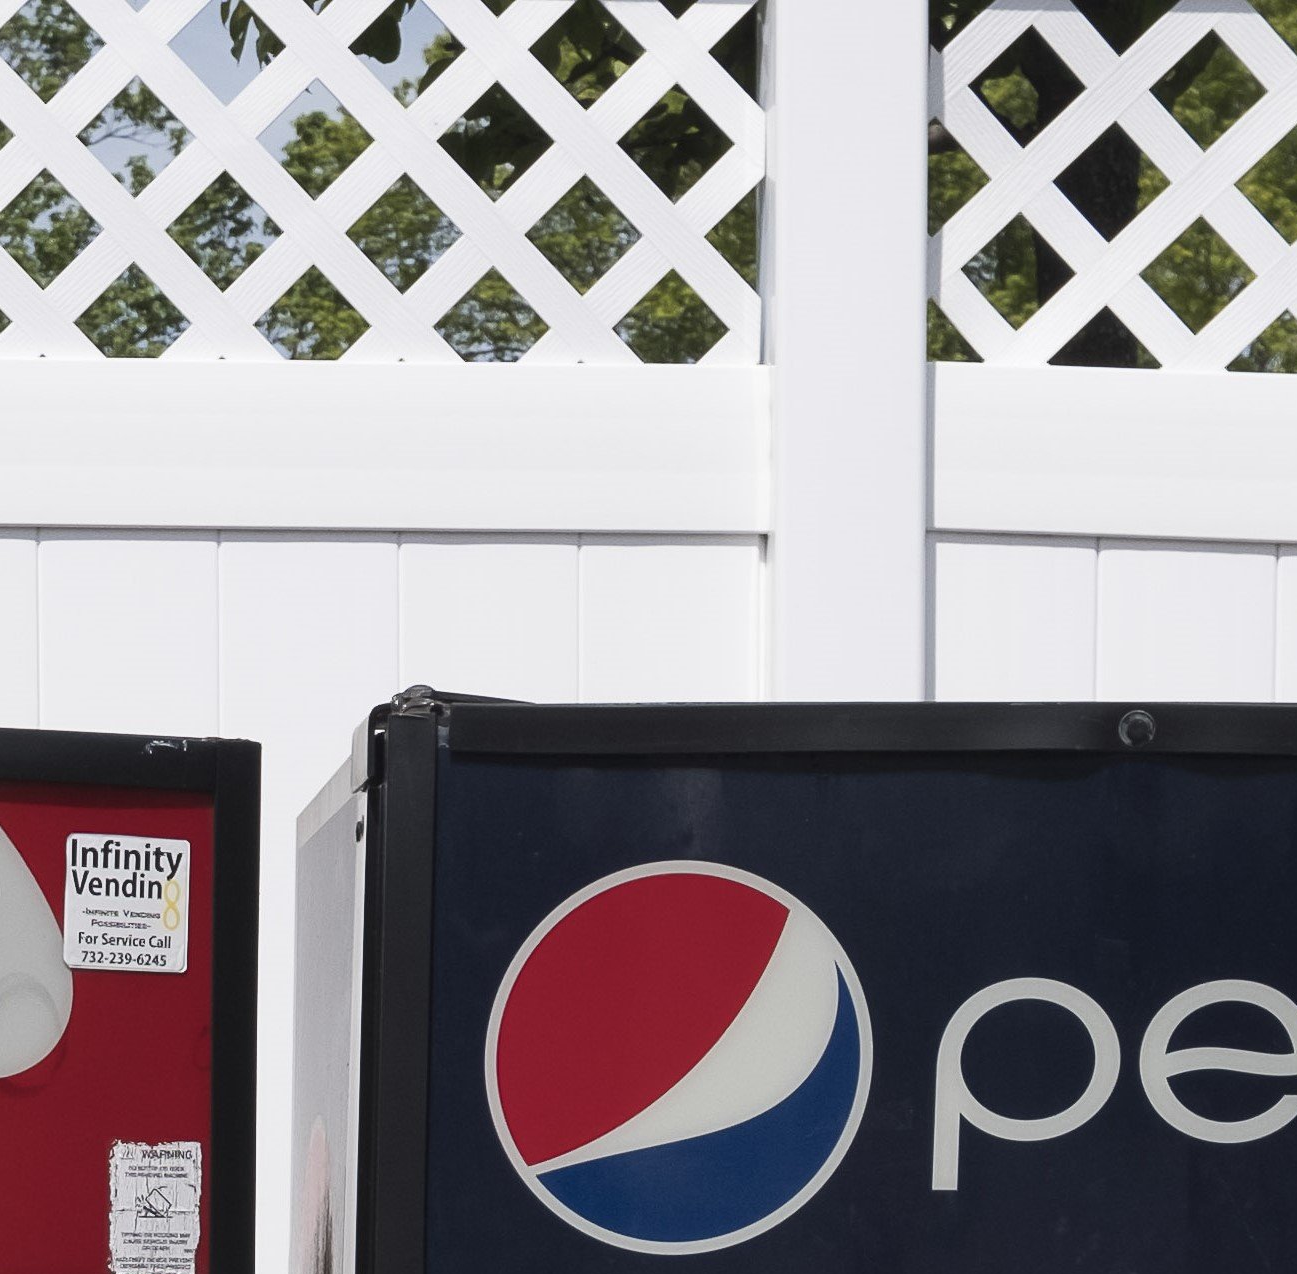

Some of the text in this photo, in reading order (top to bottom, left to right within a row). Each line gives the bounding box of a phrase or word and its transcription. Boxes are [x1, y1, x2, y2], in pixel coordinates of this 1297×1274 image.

[71, 838, 183, 881] Infinity
[78, 931, 171, 948] For Service Call
[81, 950, 167, 967] 732-239-6245
